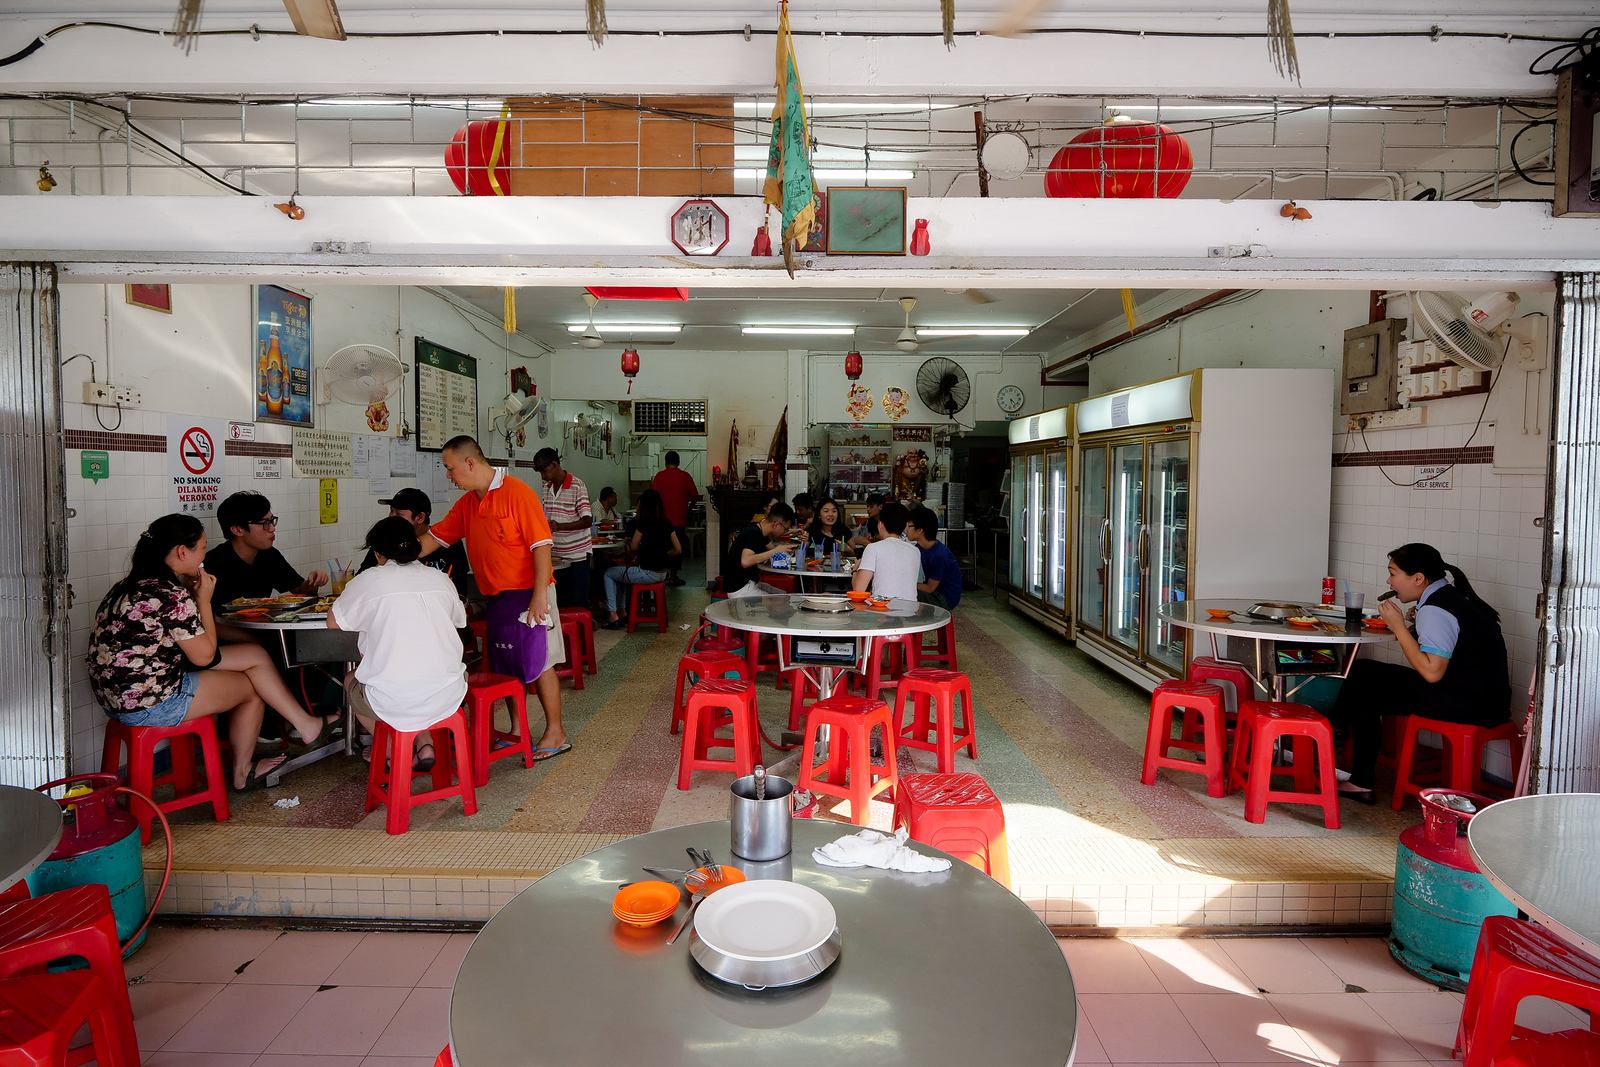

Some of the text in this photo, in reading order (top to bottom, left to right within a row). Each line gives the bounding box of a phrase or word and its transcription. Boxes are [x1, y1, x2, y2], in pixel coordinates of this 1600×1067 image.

[282, 300, 297, 314] Tiger
[177, 485, 218, 493] DILARANG
[179, 494, 217, 502] MEROKOK
[325, 493, 332, 506] B
